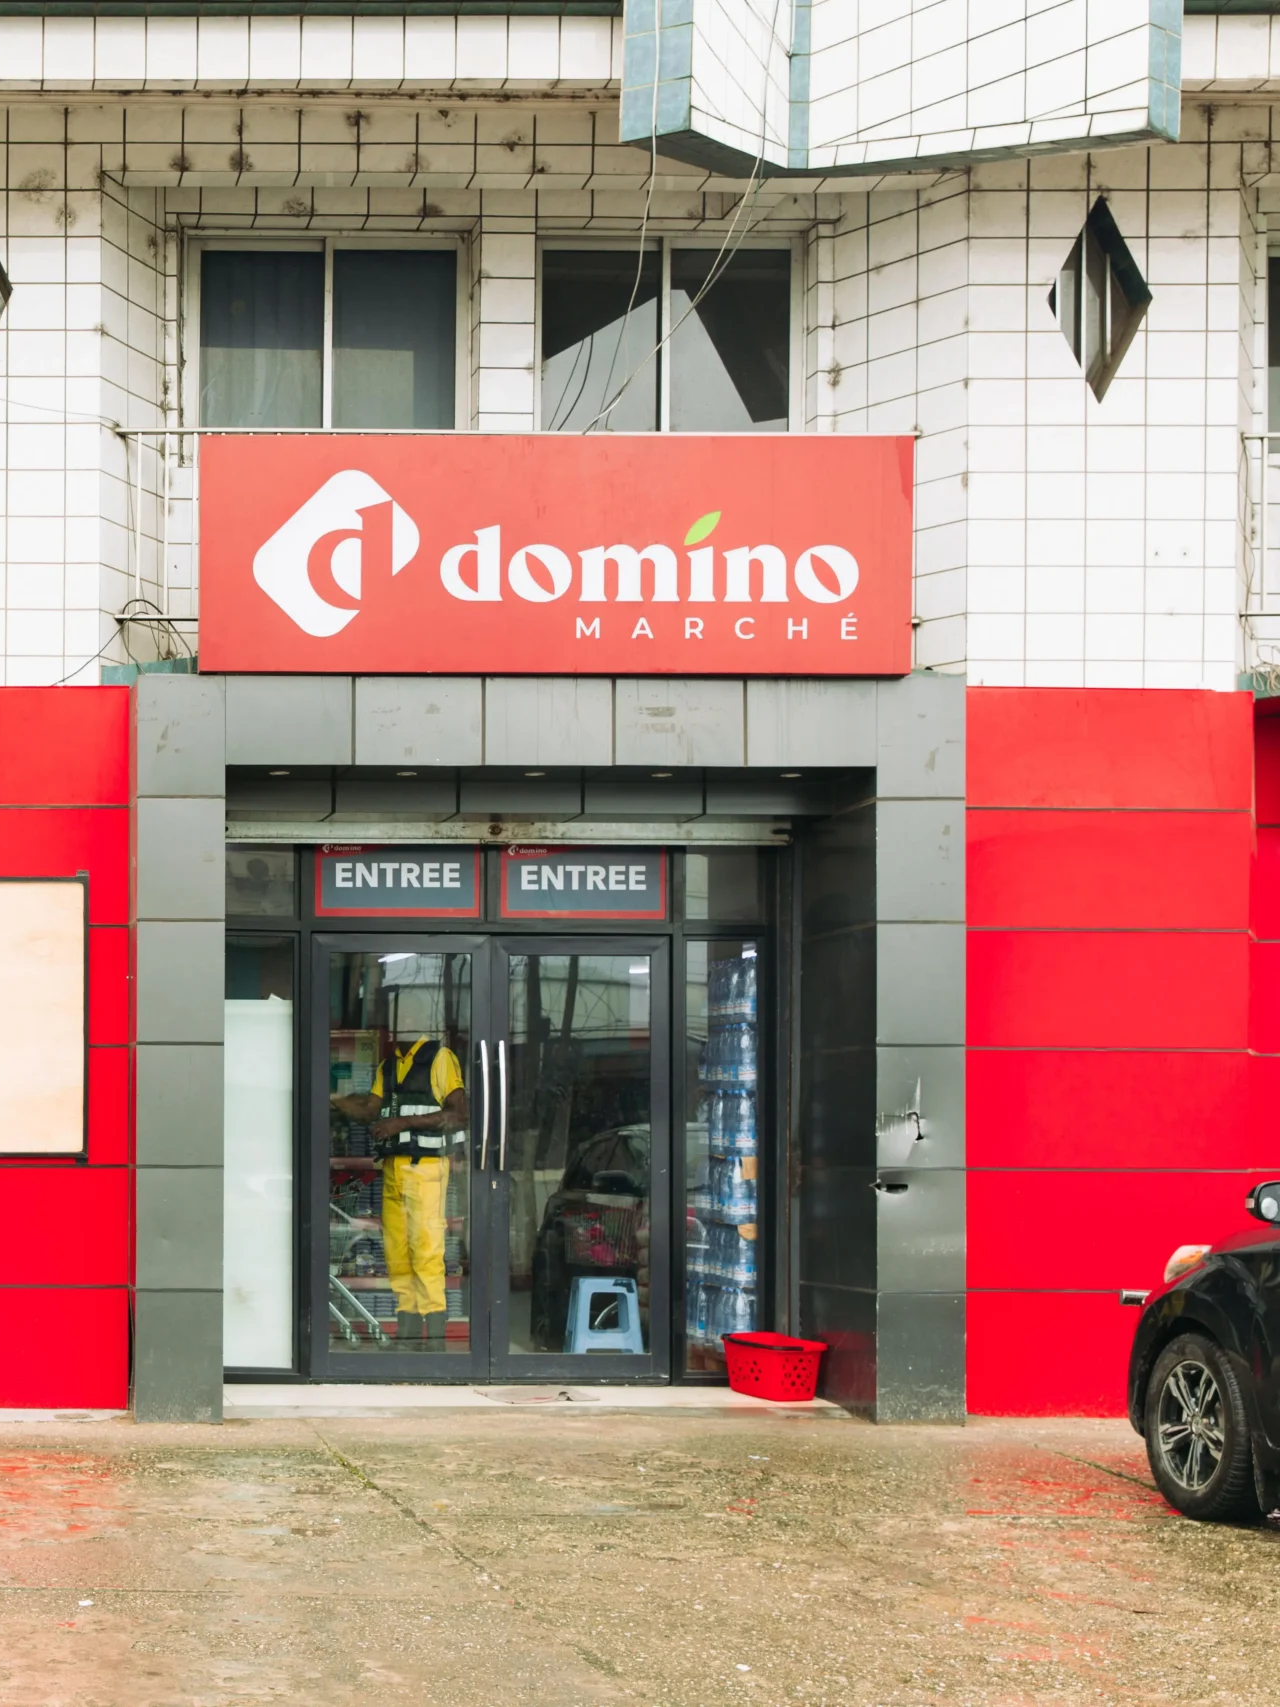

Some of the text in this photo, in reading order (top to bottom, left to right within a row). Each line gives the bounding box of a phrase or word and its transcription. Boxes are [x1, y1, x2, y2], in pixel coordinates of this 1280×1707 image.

[440, 511, 859, 603] domino
[575, 613, 858, 640] MARCHÉ
[335, 862, 461, 888] ENTREE
[520, 865, 647, 891] ENTREE
